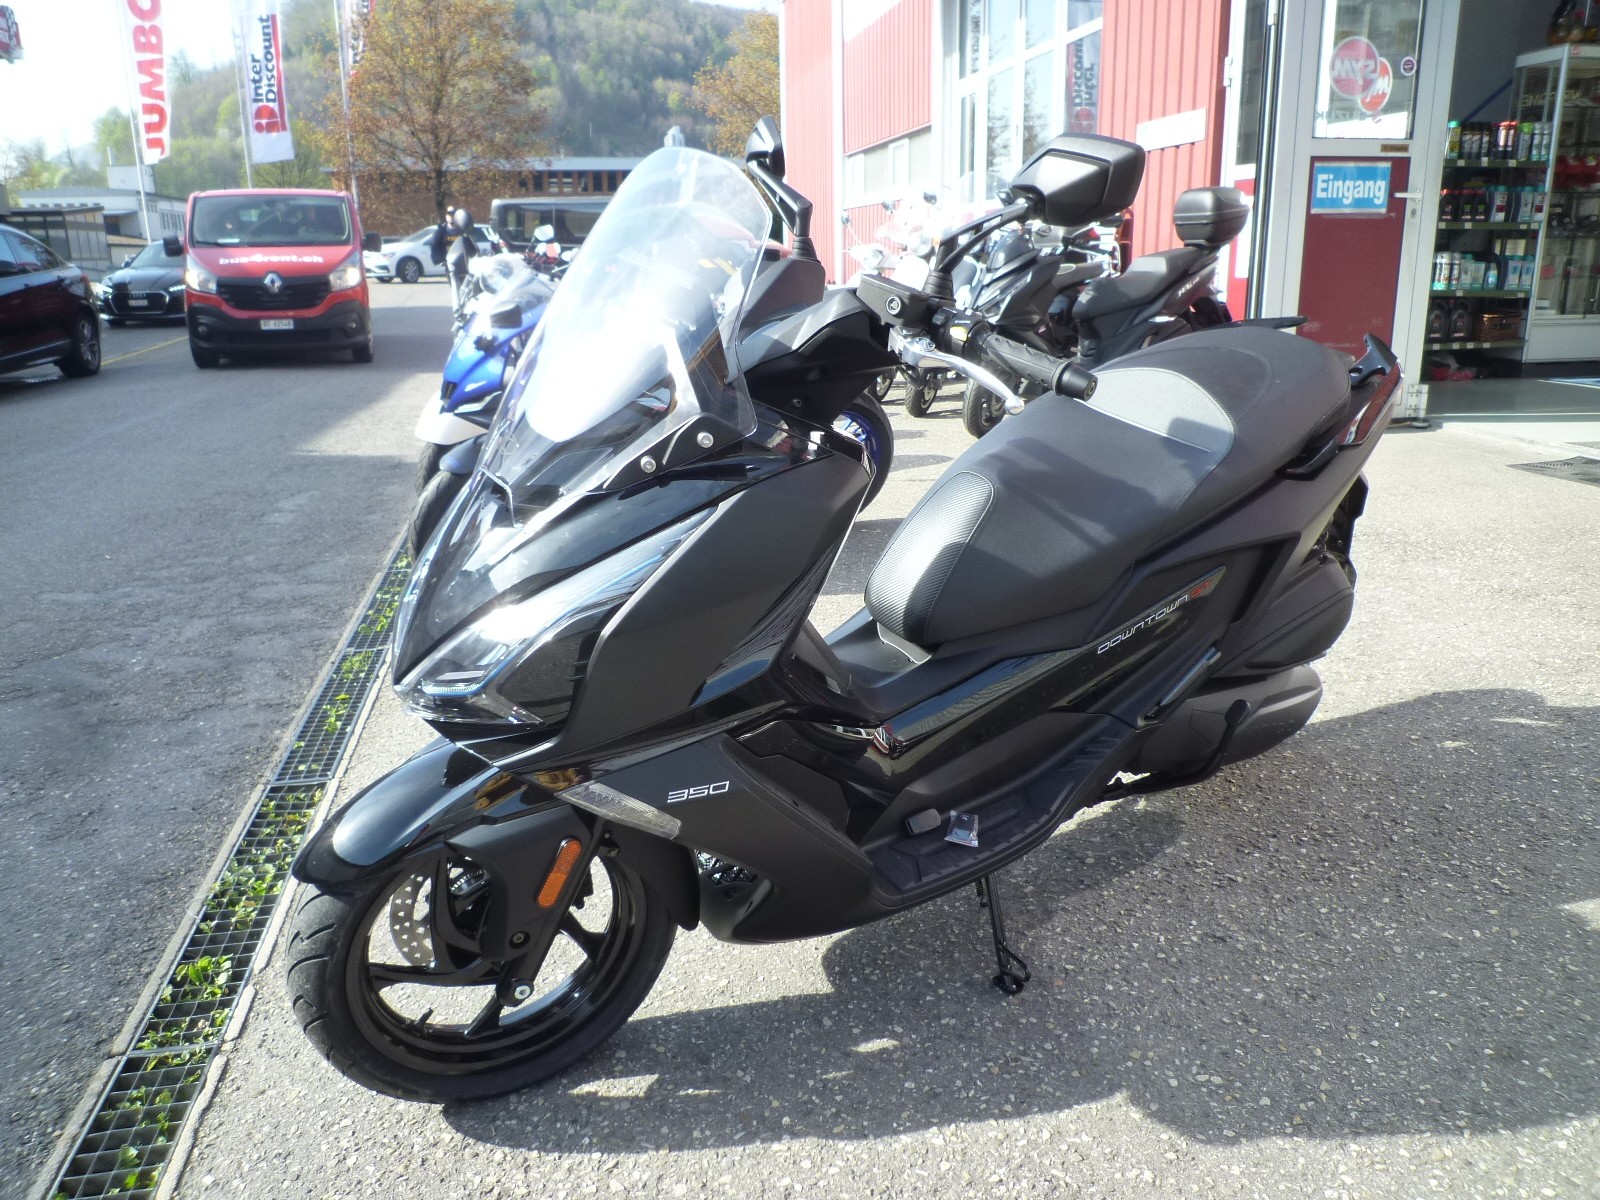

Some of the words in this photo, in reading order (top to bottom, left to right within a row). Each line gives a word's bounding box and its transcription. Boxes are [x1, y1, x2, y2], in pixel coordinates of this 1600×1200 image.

[126, 0, 168, 156] JUMBO
[250, 54, 265, 104] Inter
[257, 14, 277, 104] Discount
[1316, 174, 1386, 205] Eingang
[1097, 594, 1188, 655] DOWNTOWN
[667, 780, 730, 803] 350
